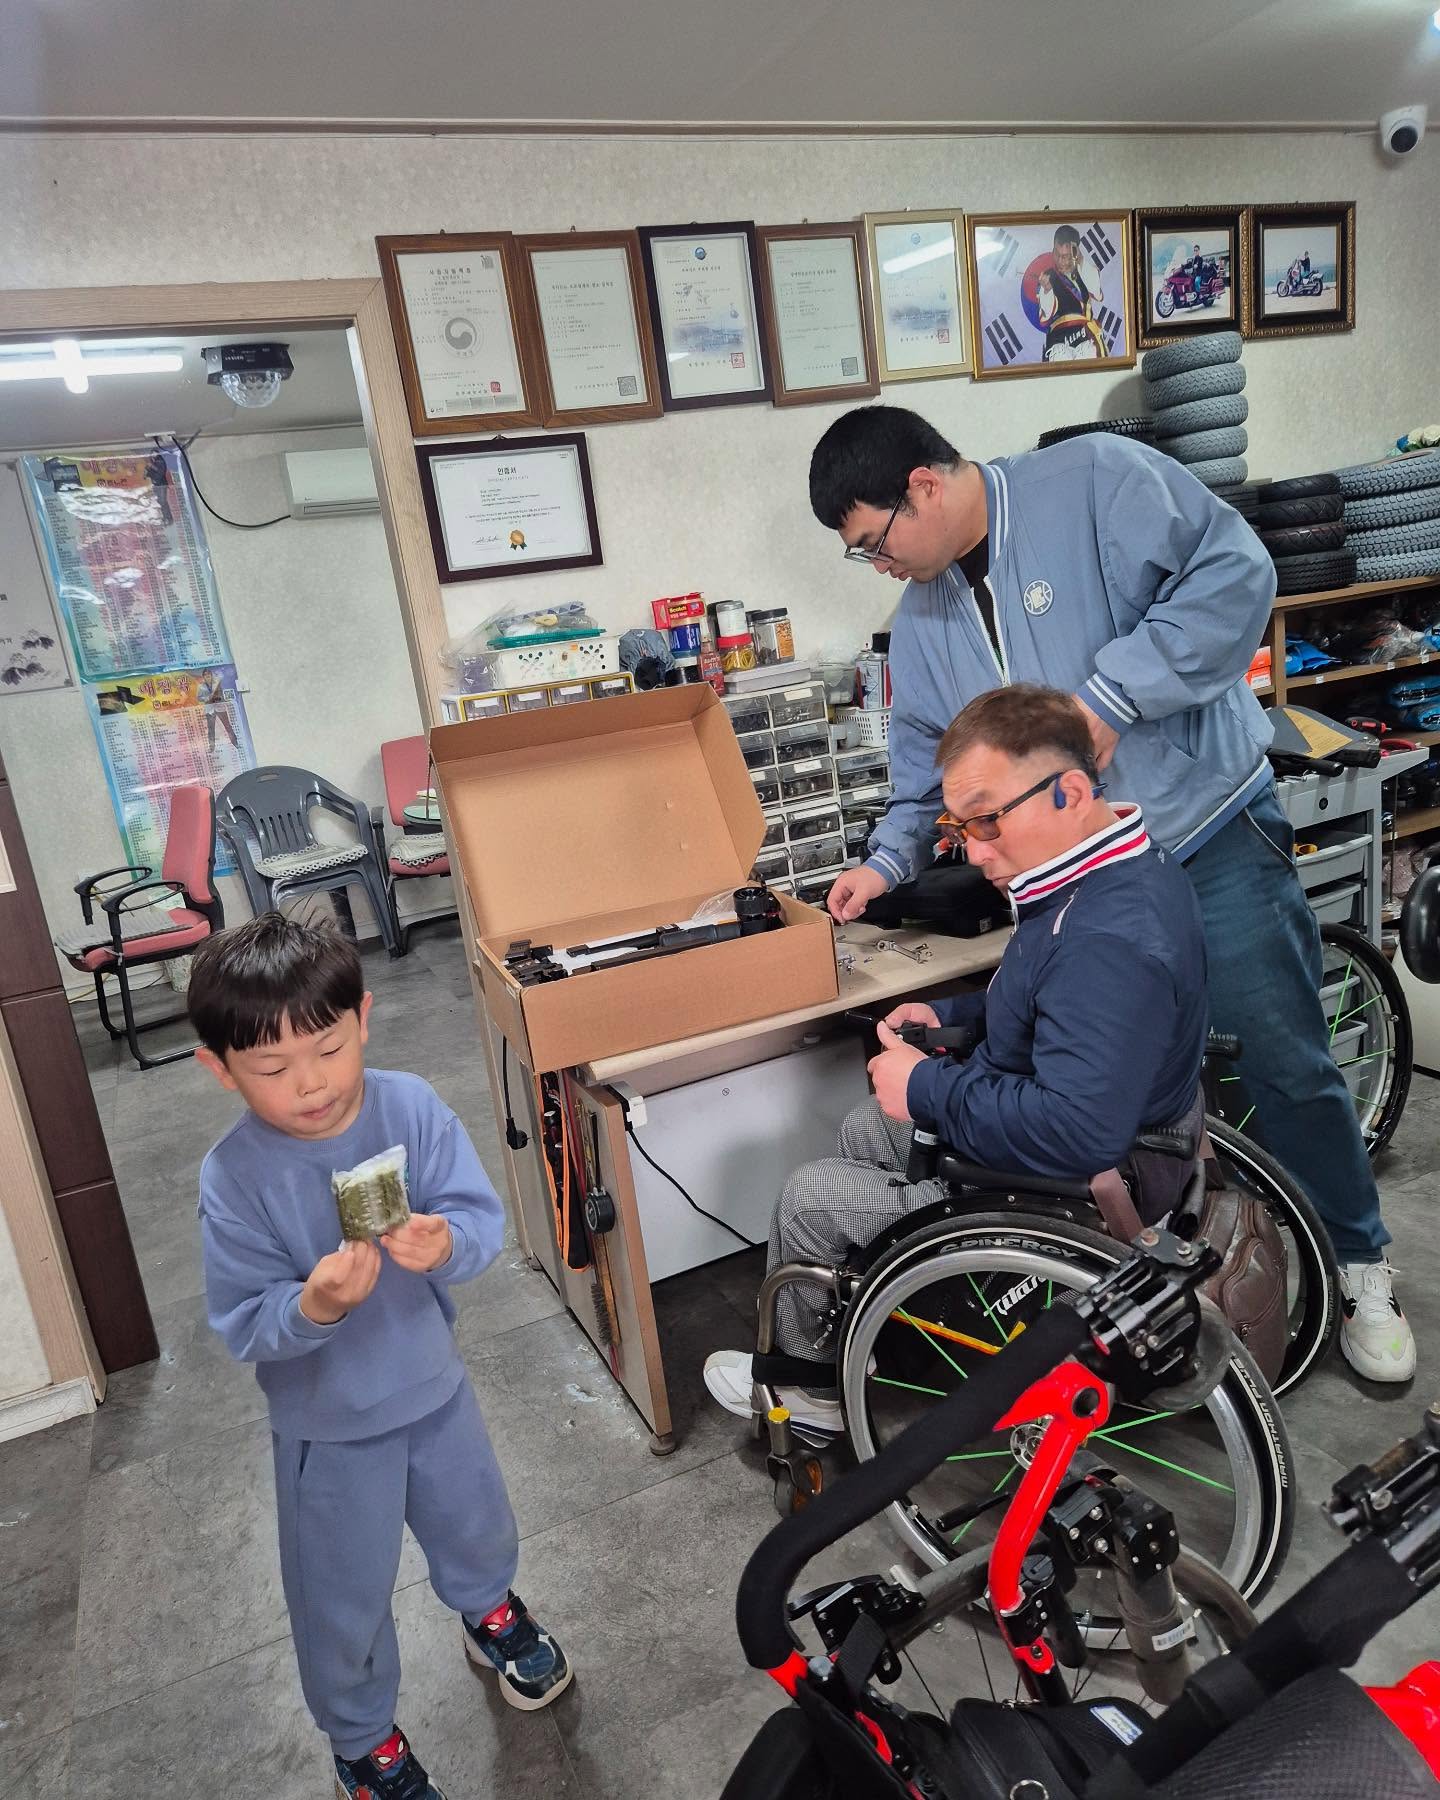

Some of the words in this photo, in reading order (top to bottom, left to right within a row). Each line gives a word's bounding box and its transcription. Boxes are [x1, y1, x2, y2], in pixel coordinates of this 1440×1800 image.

[497, 466, 517, 476] 인증서
[669, 605, 687, 614] Scotch
[1260, 1402, 1288, 1488] MARATHON
